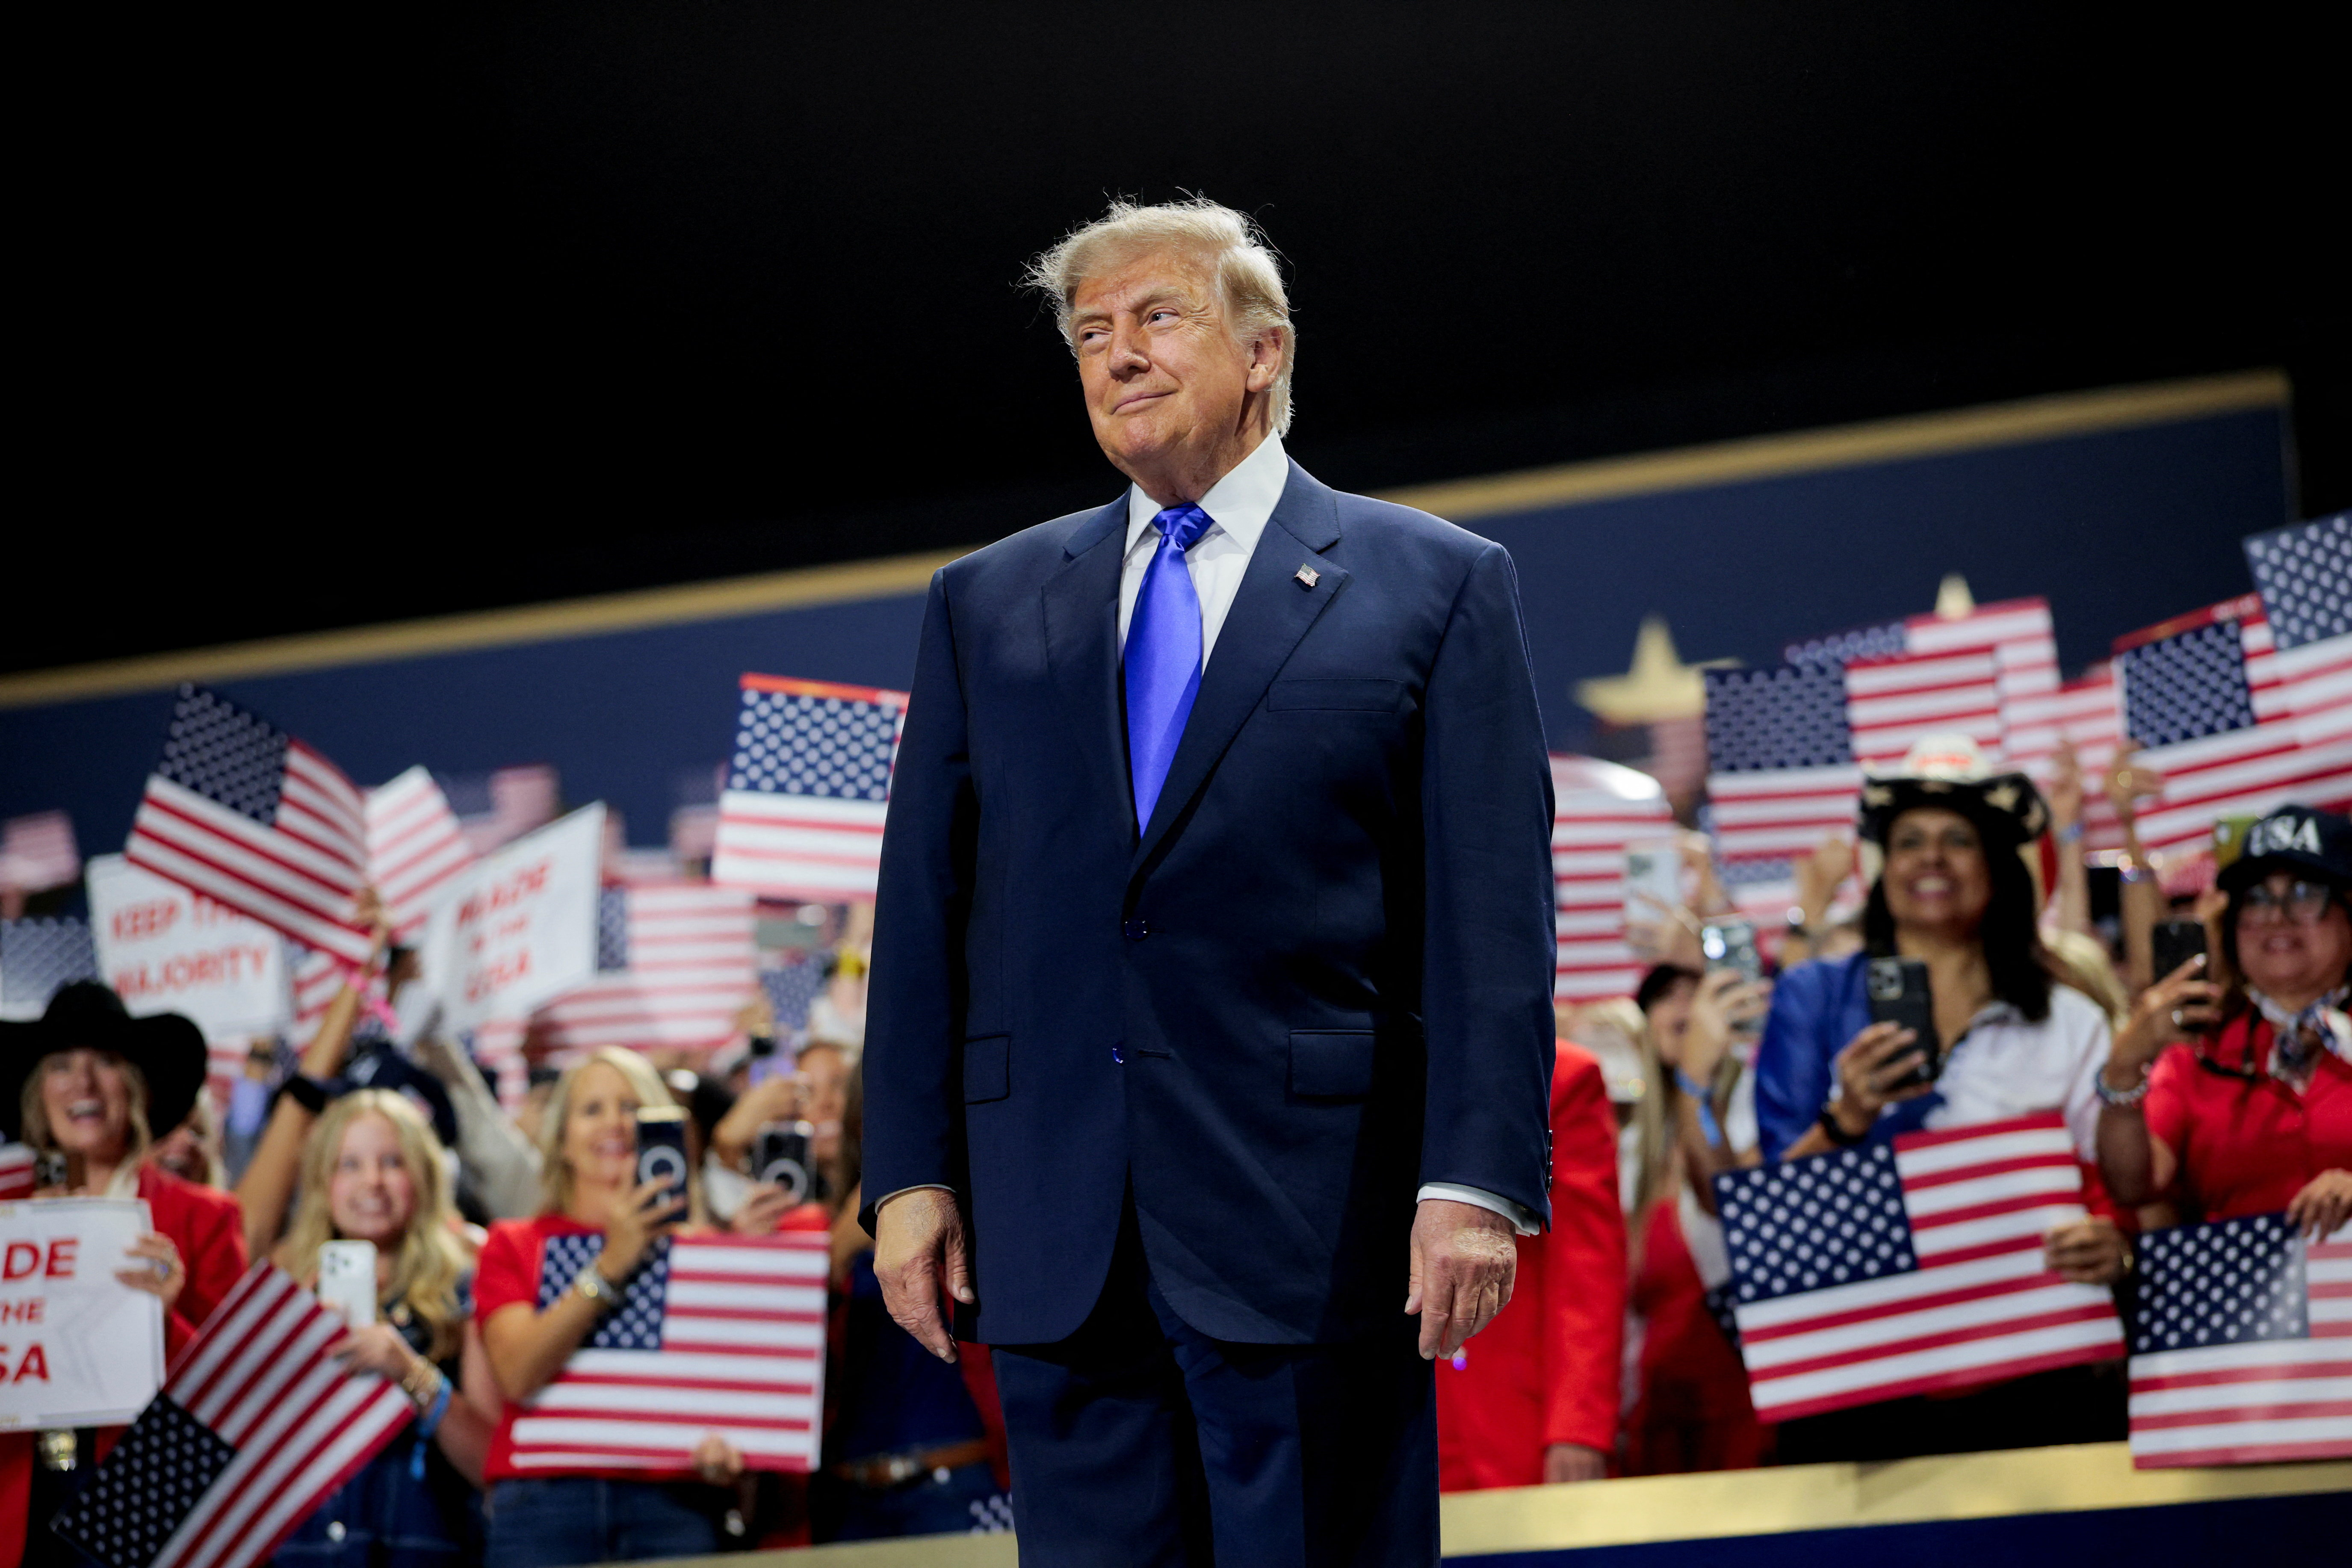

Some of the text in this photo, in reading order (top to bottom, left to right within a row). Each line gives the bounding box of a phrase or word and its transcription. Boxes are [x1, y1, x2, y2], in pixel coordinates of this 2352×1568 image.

[2249, 815, 2322, 856] USA
[112, 895, 250, 941] KEEP TH
[115, 943, 269, 998] MAJORITY
[3, 1237, 79, 1280] DE
[0, 1298, 44, 1323] HE
